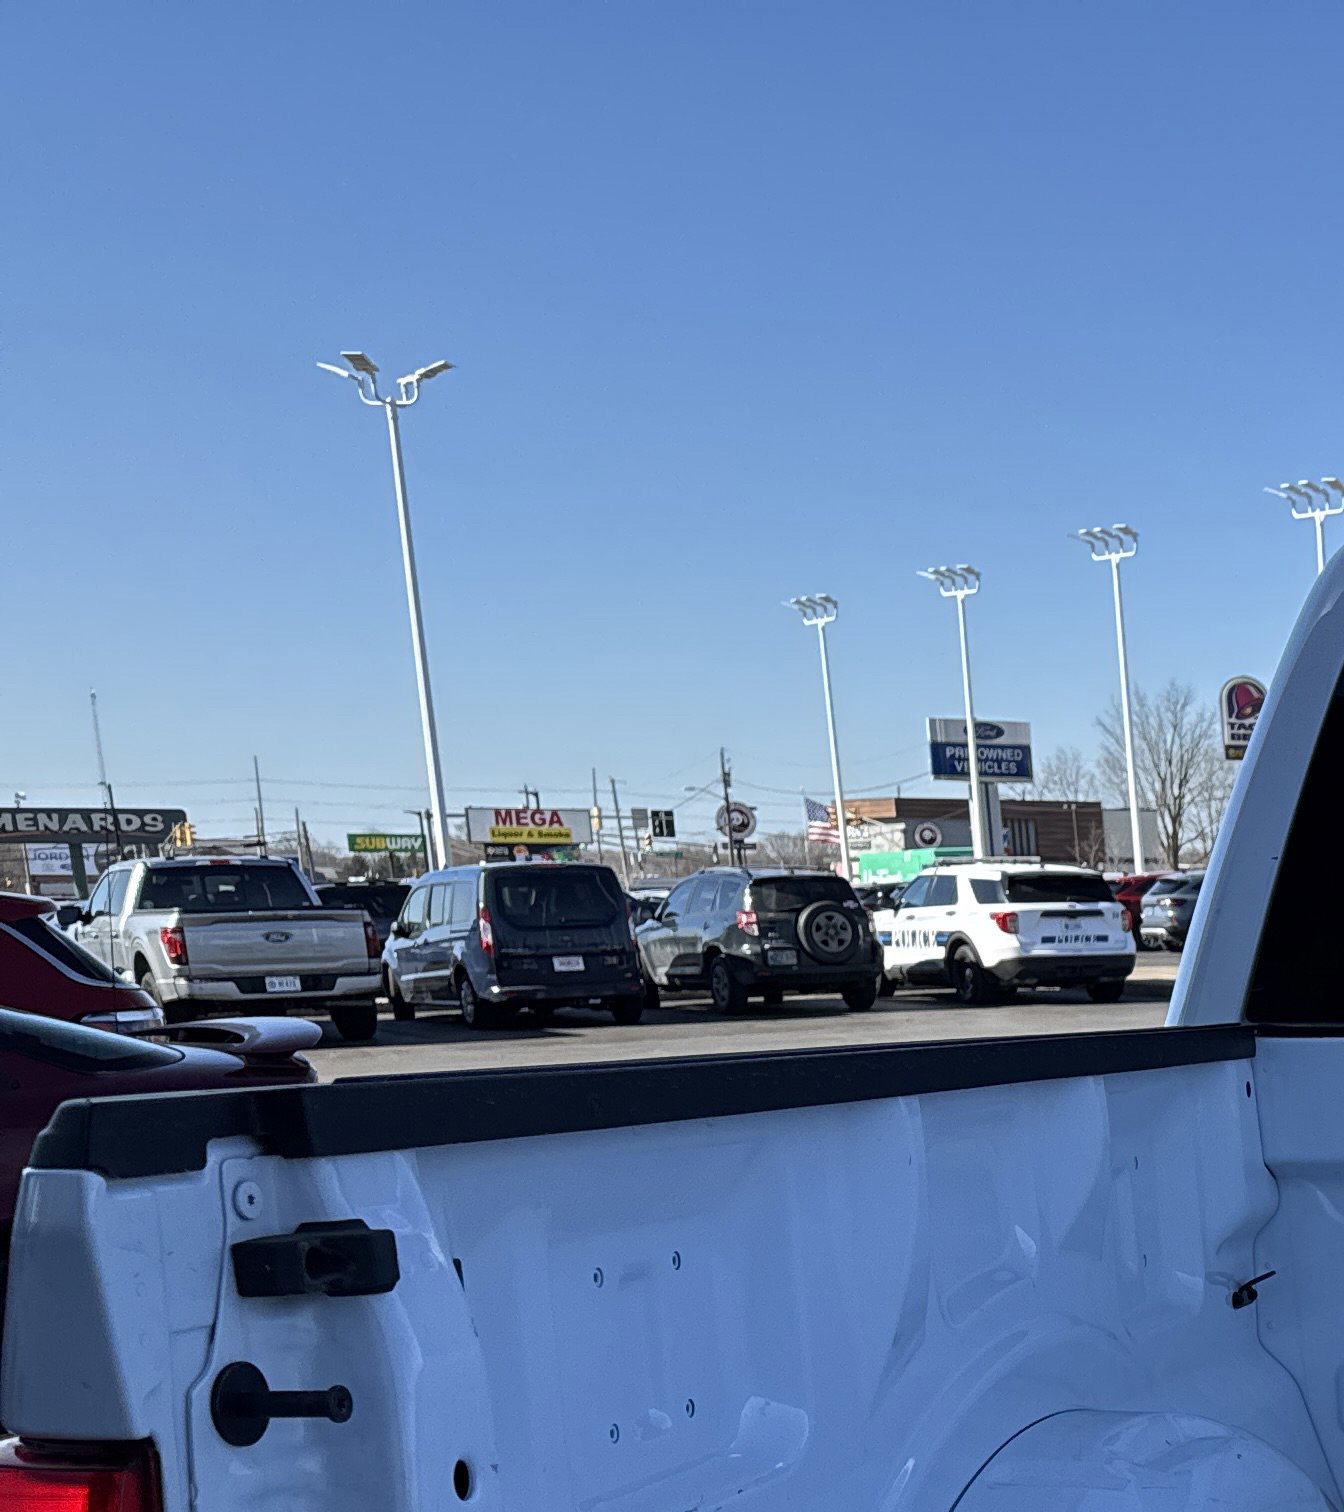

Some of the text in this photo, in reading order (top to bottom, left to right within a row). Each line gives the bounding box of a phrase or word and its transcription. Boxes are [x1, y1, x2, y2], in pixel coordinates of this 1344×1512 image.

[1228, 722, 1255, 731] TAC
[946, 746, 1023, 761] PROWNED
[954, 760, 1018, 774] VICLES
[494, 808, 565, 827] MEGA
[355, 836, 424, 851] SUBWAY
